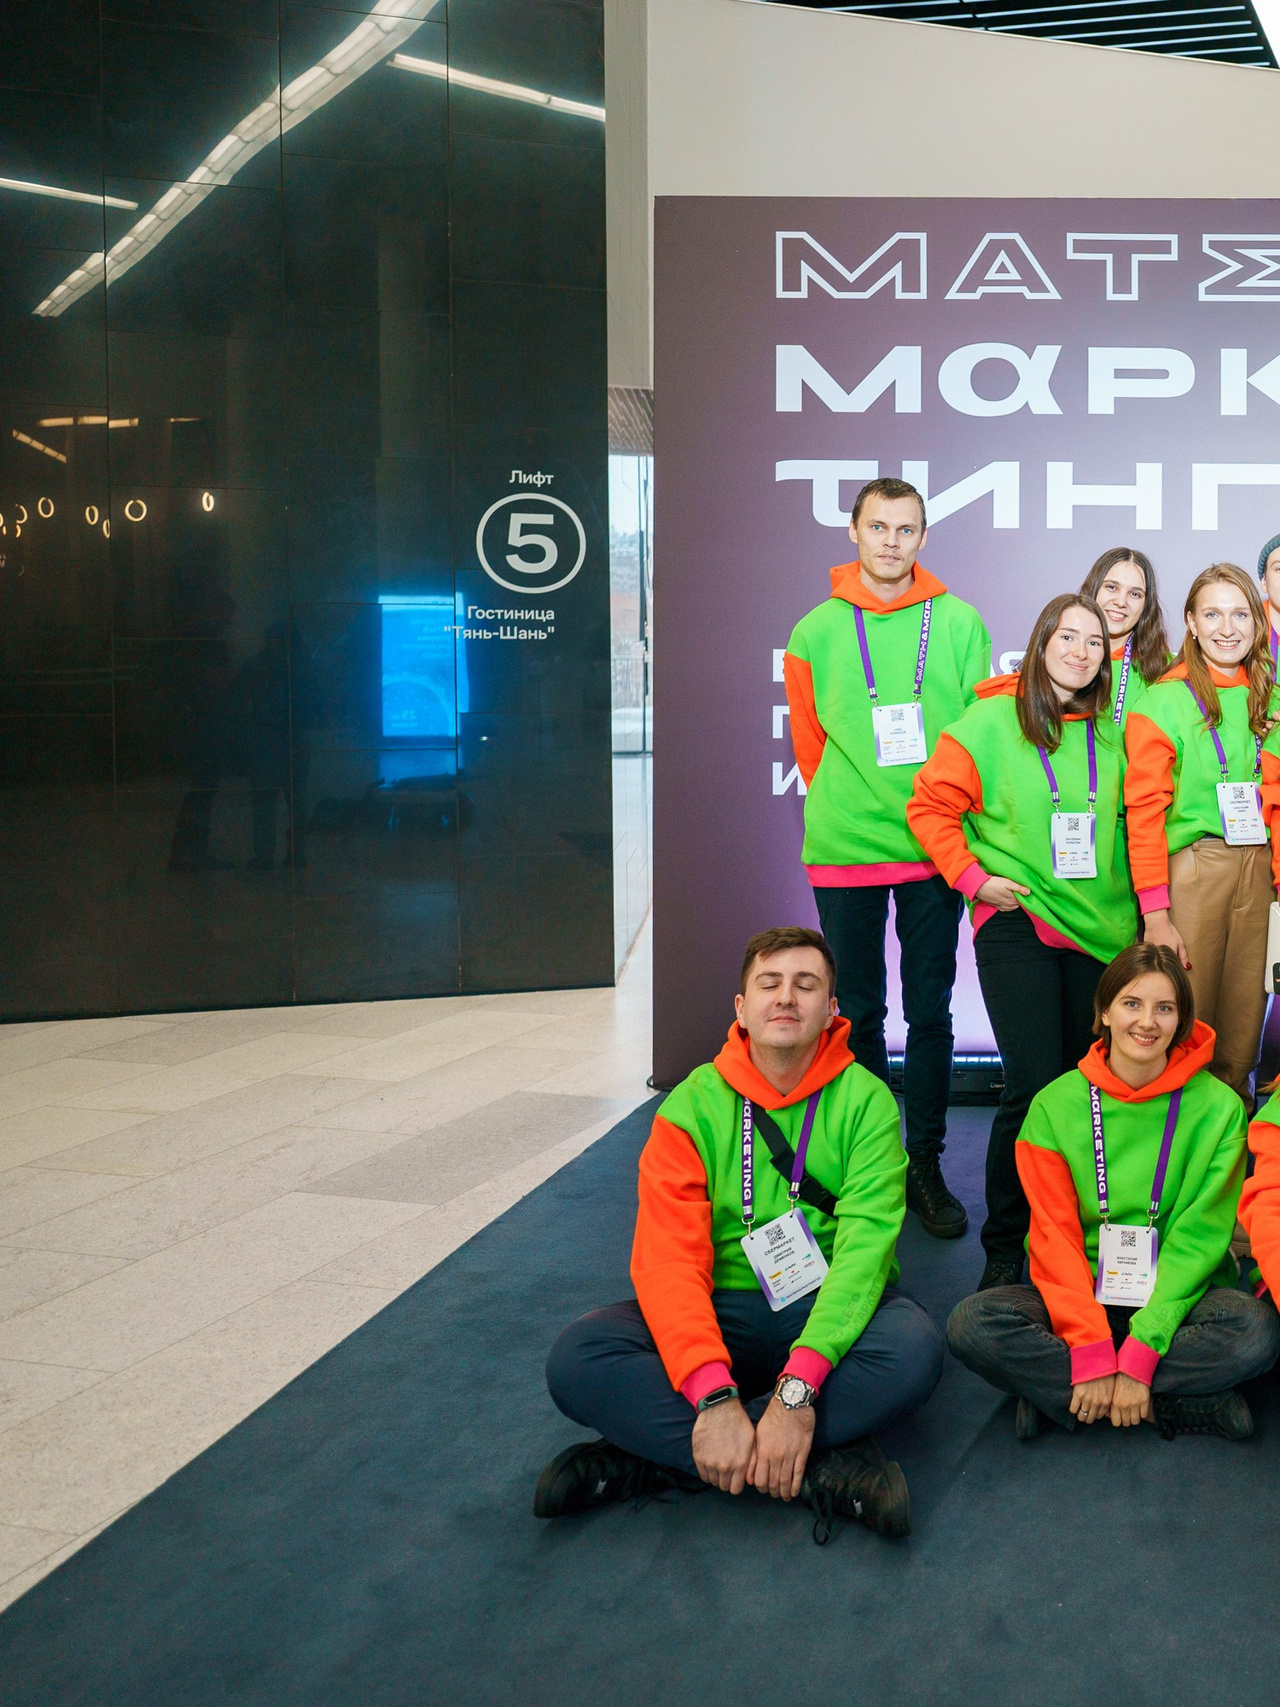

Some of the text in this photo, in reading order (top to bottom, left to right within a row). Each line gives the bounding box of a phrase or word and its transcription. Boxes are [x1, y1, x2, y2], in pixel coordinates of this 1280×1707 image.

[508, 469, 555, 488] Лифт
[504, 512, 559, 575] 5
[466, 605, 556, 623] Гостиница
[443, 625, 556, 641] "Тянь-Шань"
[1090, 1085, 1107, 1194] MARKETING
